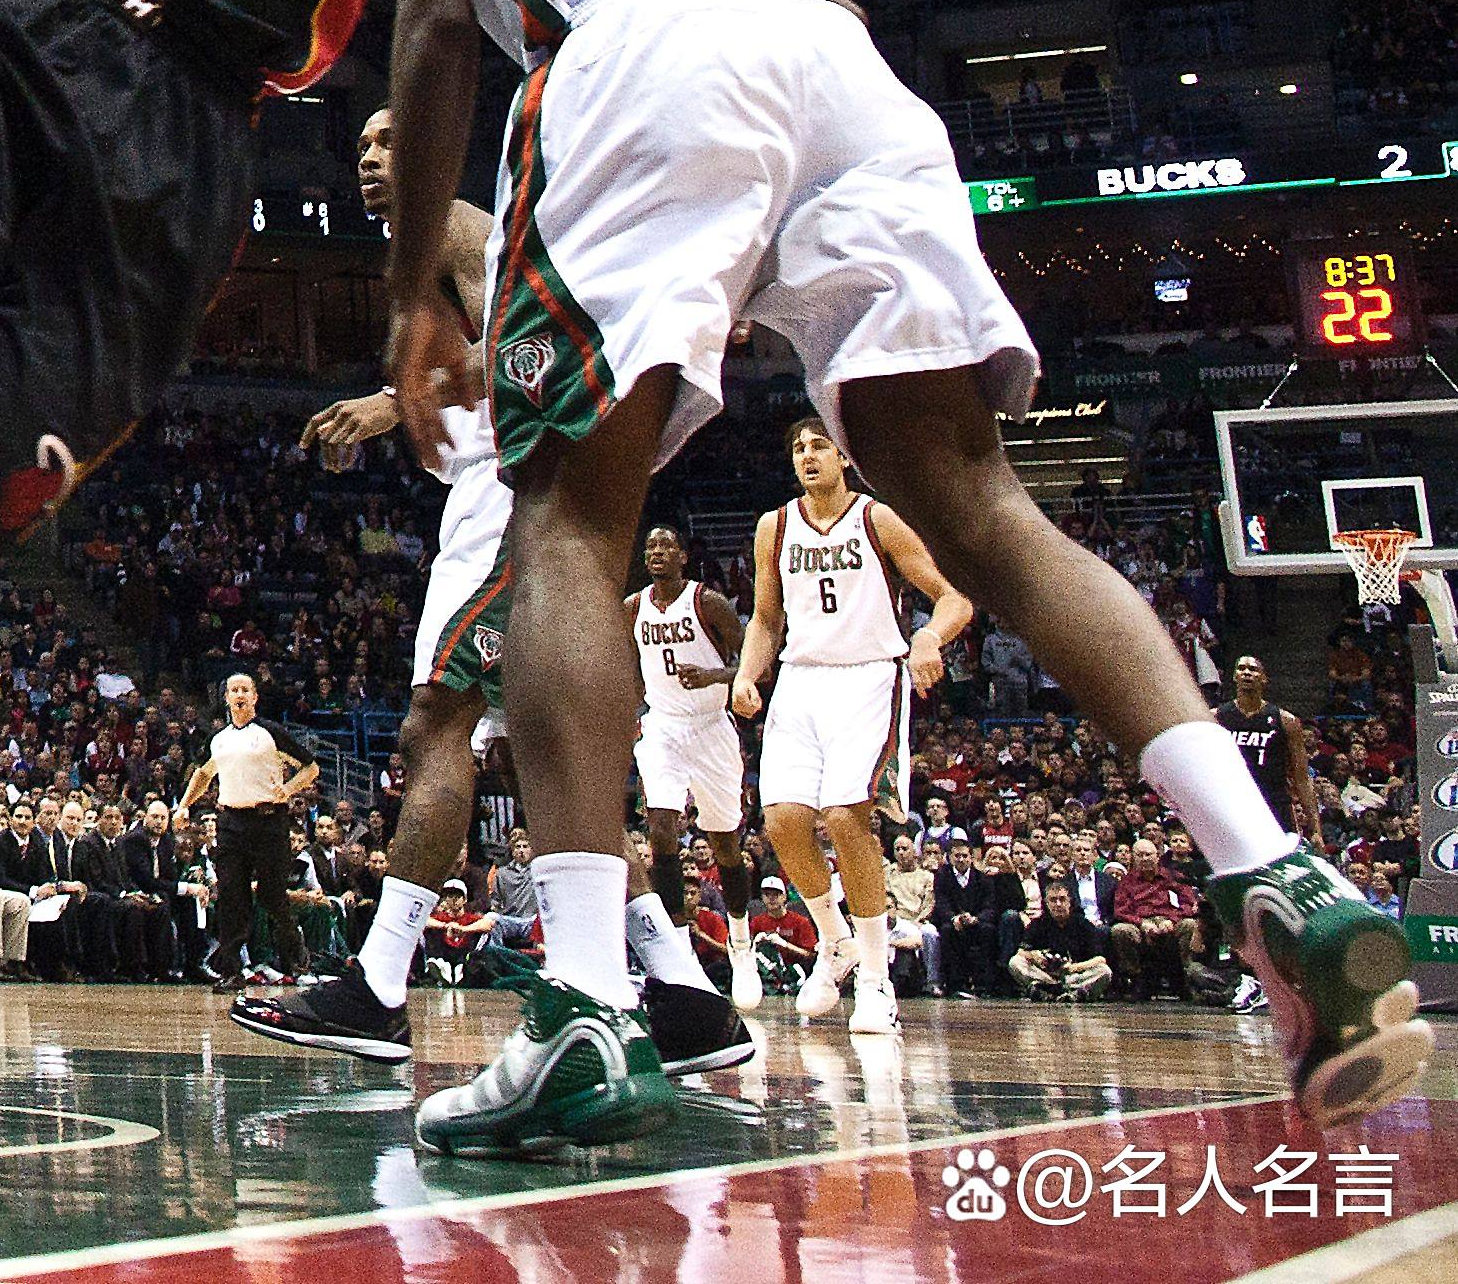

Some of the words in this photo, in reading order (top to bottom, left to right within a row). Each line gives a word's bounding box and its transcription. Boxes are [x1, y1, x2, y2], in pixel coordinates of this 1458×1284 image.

[1096, 157, 1247, 196] BUCKS
[1377, 144, 1413, 179] 2
[1323, 253, 1397, 288] 8:37
[1320, 288, 1394, 345] 22
[1198, 363, 1288, 380] FRONTIER
[788, 538, 863, 574] BUCKS
[818, 577, 838, 614] 6
[641, 616, 696, 646] BUCKS
